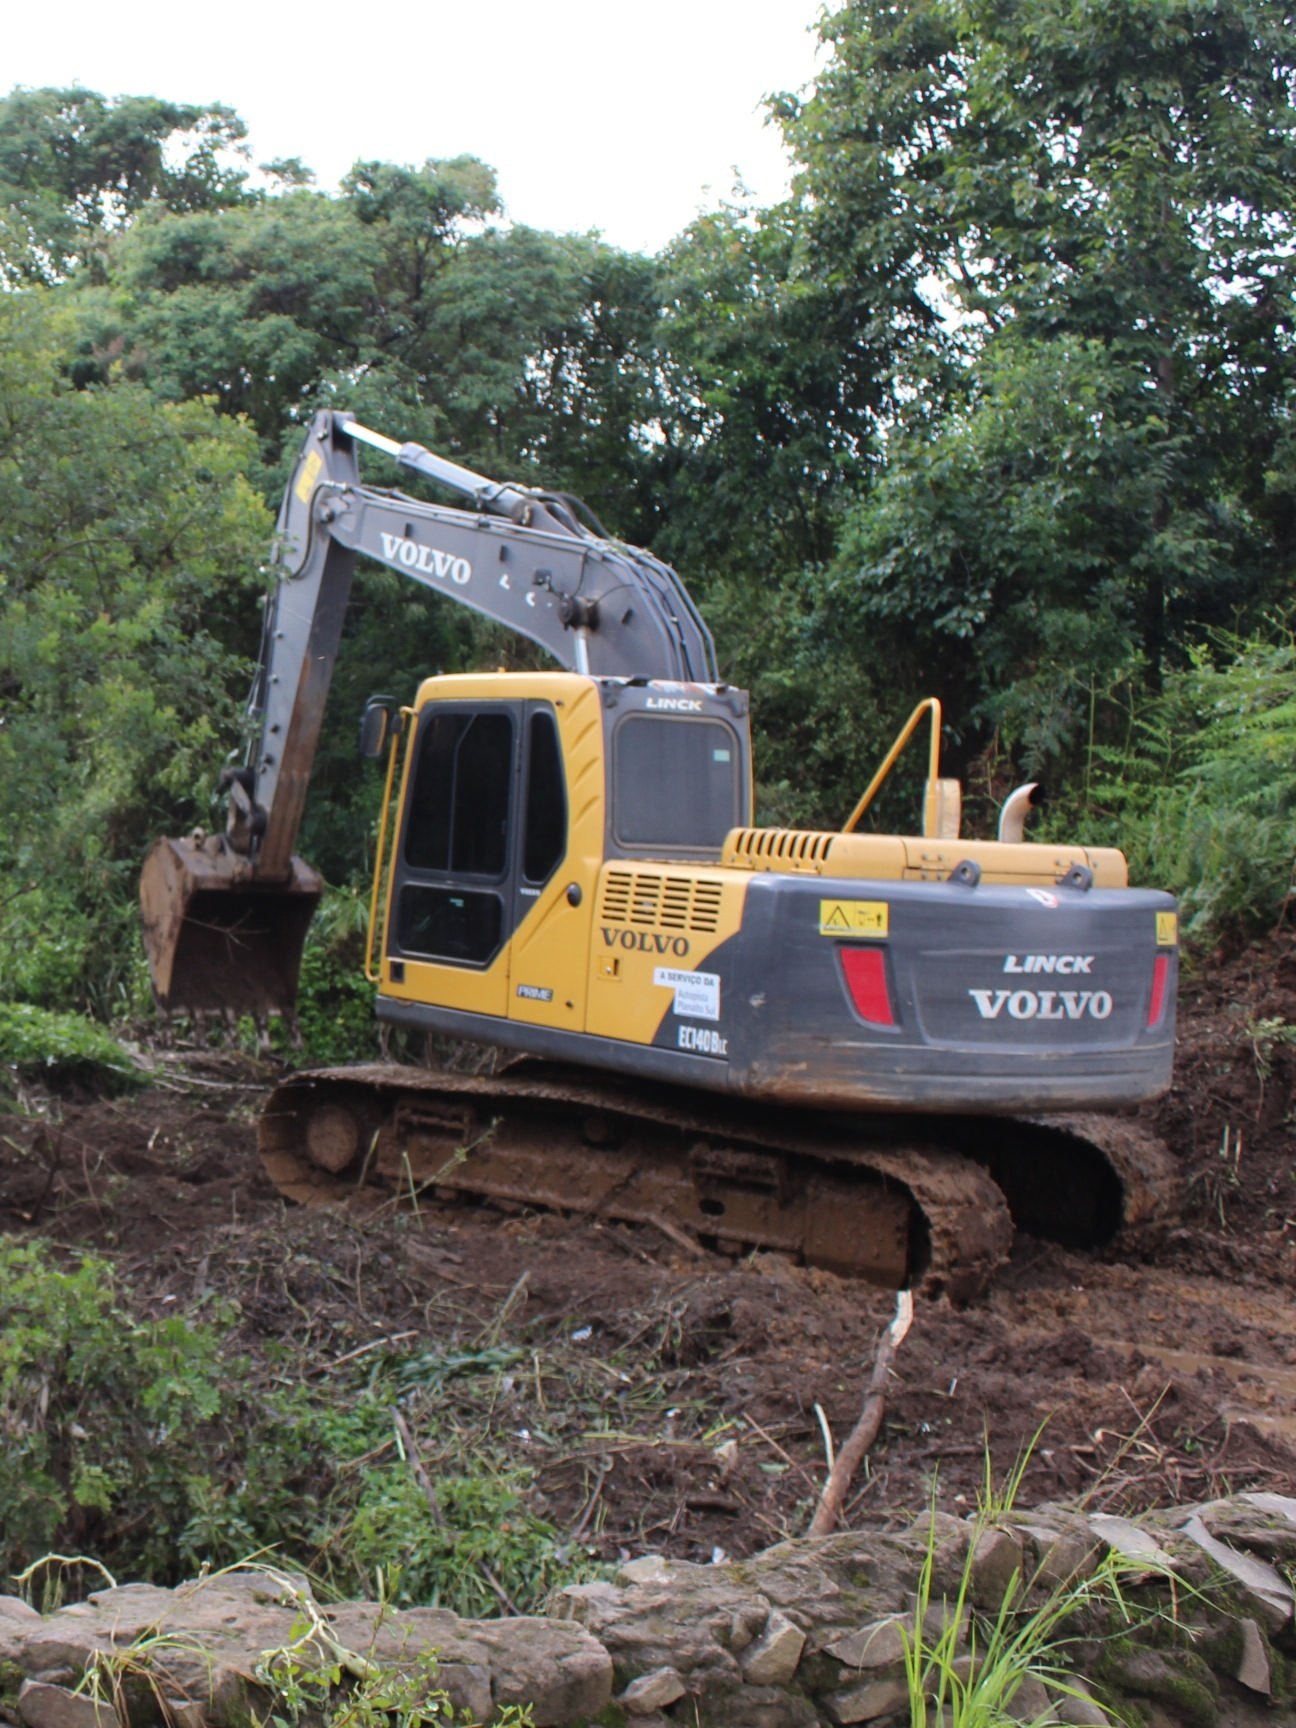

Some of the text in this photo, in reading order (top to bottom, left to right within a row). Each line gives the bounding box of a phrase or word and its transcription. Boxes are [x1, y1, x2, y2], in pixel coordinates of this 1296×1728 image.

[380, 532, 472, 585] VOLVO
[646, 697, 703, 711] LINCK
[600, 926, 689, 957] VOLVO
[1003, 955, 1095, 974] LINCK
[660, 971, 715, 987] A SERVIÇO DA
[968, 989, 1113, 1019] VOLVO
